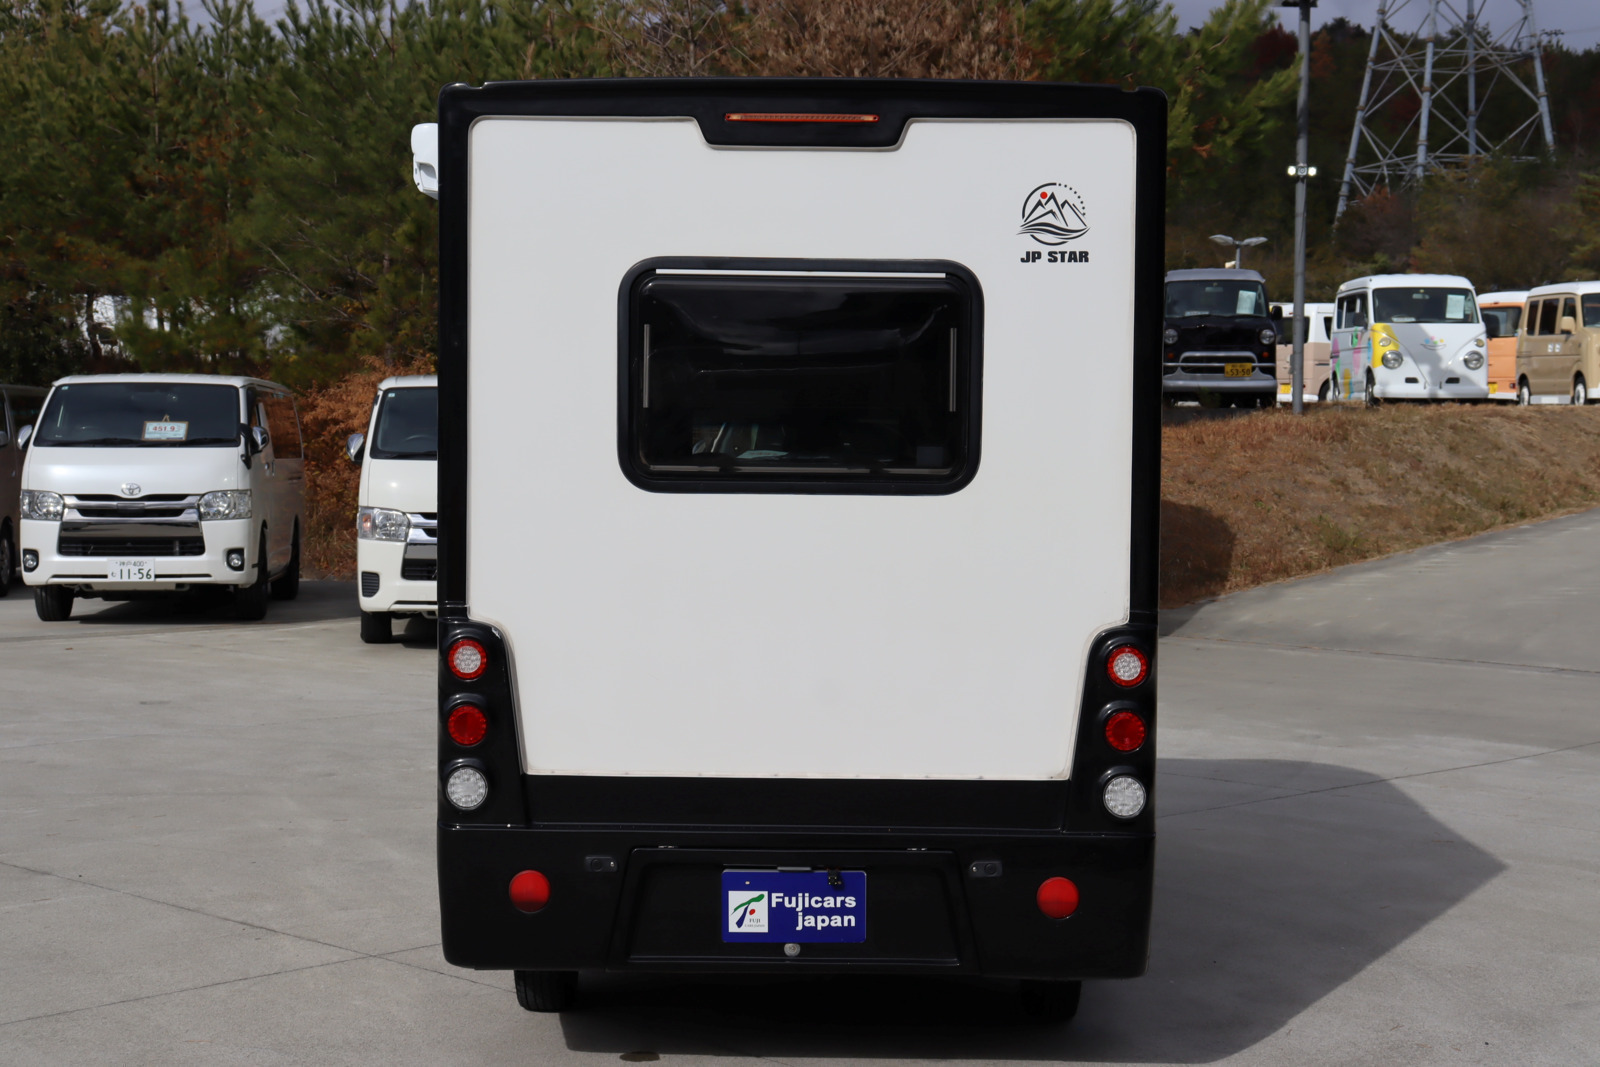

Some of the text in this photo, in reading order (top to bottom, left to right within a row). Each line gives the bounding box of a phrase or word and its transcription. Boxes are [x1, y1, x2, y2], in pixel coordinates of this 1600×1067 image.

[1020, 251, 1089, 263] JP STAR
[119, 567, 152, 580] 11-56
[771, 892, 857, 912] Fujicars
[795, 912, 856, 931] japan
